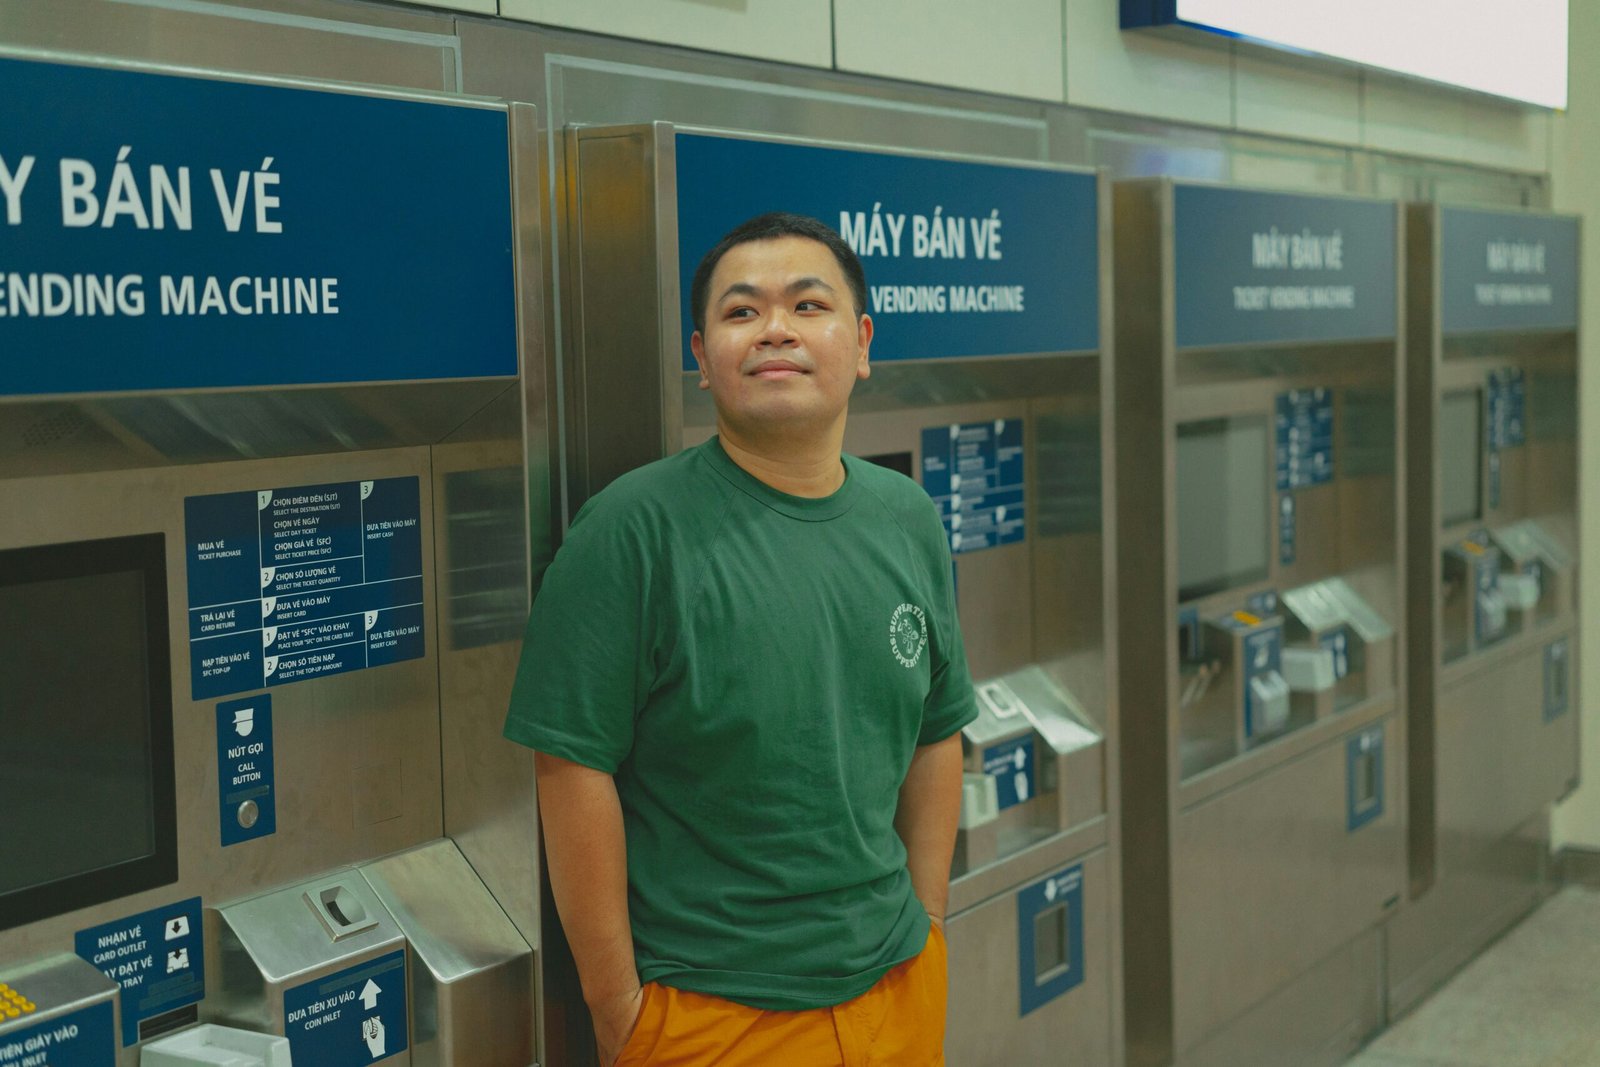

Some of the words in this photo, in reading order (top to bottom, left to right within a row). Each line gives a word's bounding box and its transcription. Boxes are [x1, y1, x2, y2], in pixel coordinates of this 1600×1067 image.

[59, 145, 192, 230] BÁN
[210, 157, 283, 233] VÉ
[840, 202, 905, 257] MÁY
[913, 206, 965, 258] BÁN
[970, 209, 1002, 259] VÉ
[160, 275, 339, 316] MACHINE
[871, 286, 946, 313] VENDING
[950, 286, 1024, 312] MACHINE
[198, 542, 214, 551] MUA
[215, 550, 242, 558] PURCHASE
[318, 576, 341, 585] QUANTITY
[277, 612, 293, 620] INSERT
[293, 610, 307, 618] CARD
[201, 624, 215, 632] CARD
[216, 622, 235, 630] RETURN
[333, 622, 350, 631] KHAY
[212, 666, 231, 675] TOP-UP
[279, 671, 295, 679] SELECT
[305, 666, 322, 674] TOP-UP
[322, 662, 343, 671] AMOUNT
[228, 746, 246, 759] NÚT
[248, 742, 264, 755] GỌI
[238, 762, 255, 773] CALL
[232, 771, 261, 785] BUTTON
[94, 950, 116, 964] CARD
[117, 940, 147, 957] OUTLET
[123, 975, 143, 988] TRAY
[327, 996, 338, 1009] XU
[339, 990, 356, 1004] VÀO
[304, 1017, 322, 1030] COIN
[322, 1010, 341, 1024] INLET
